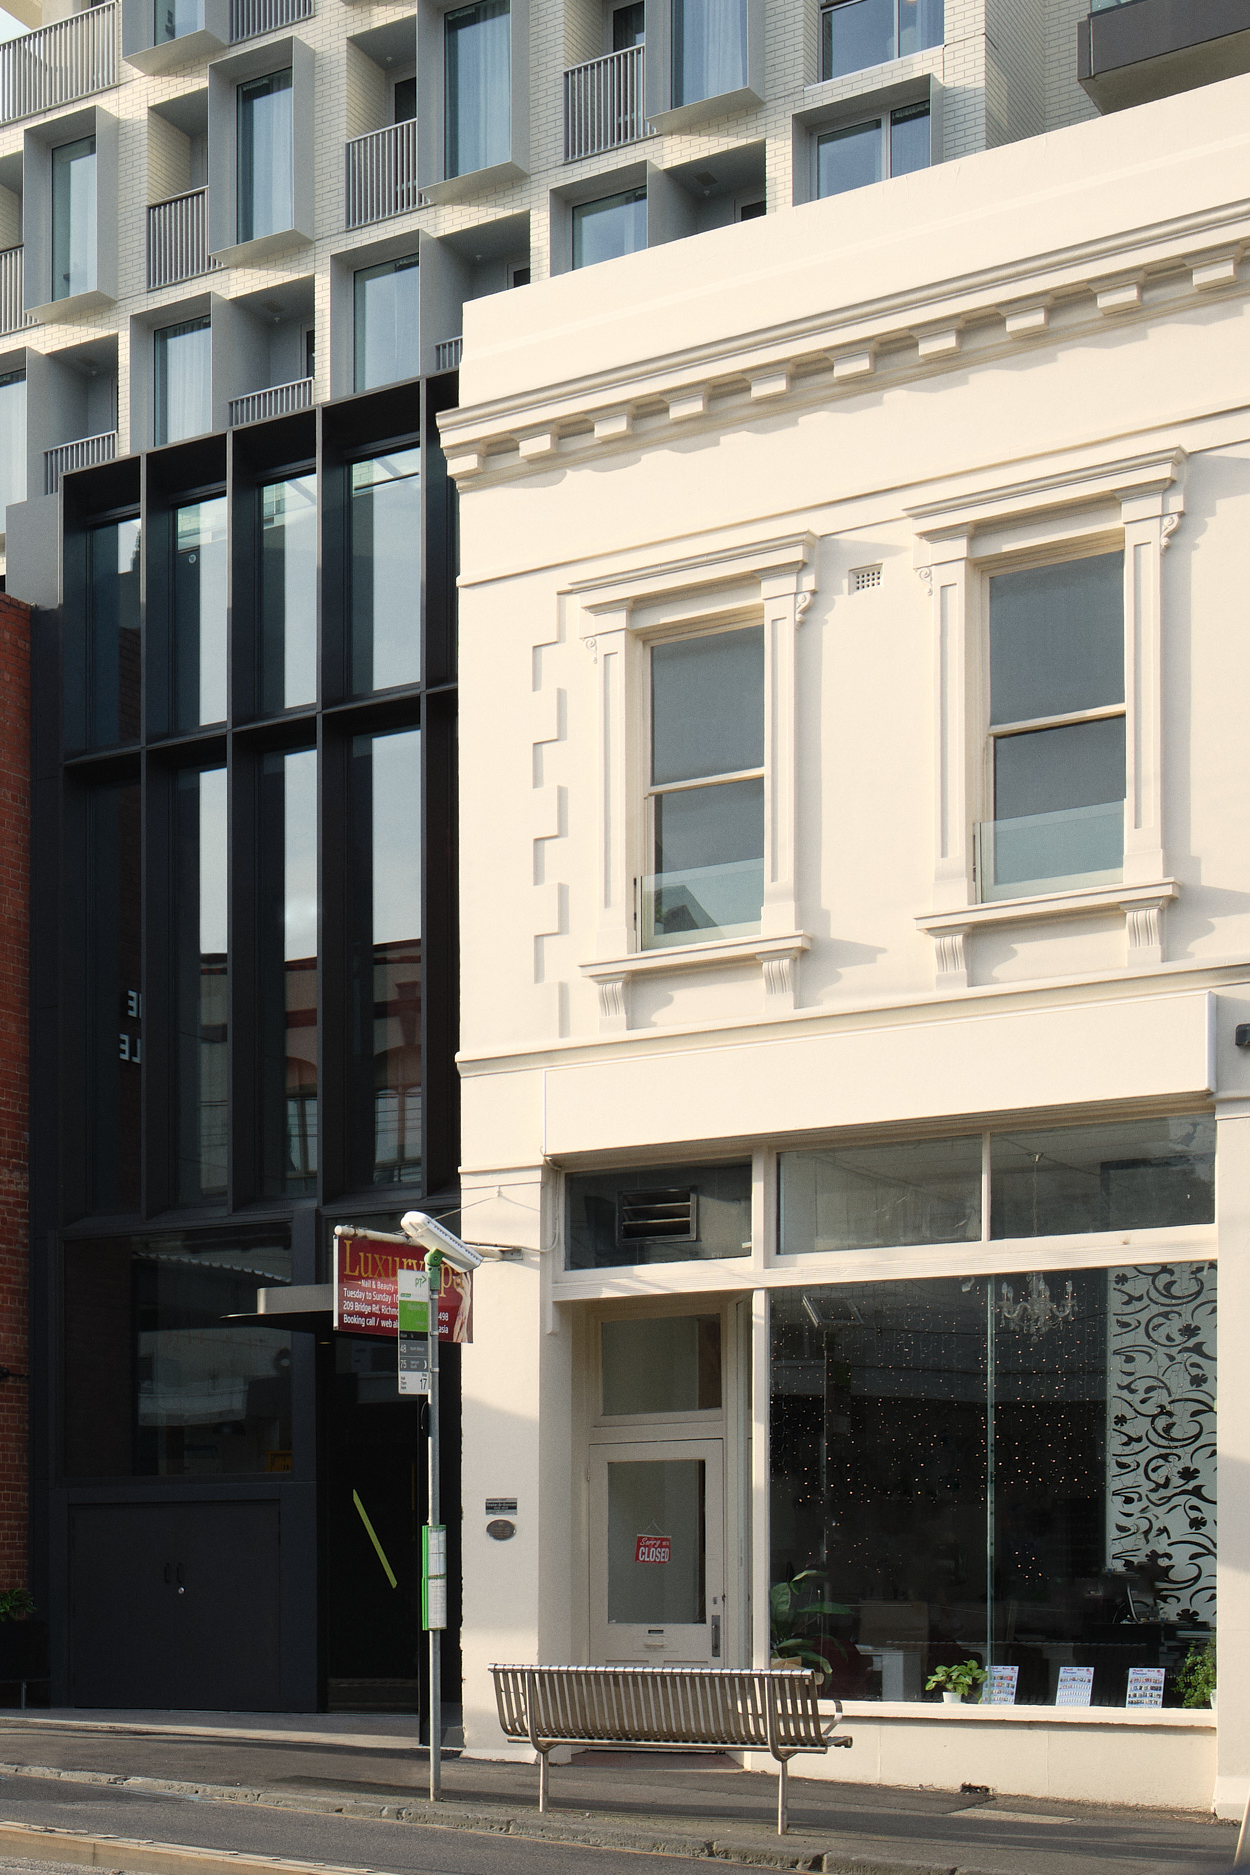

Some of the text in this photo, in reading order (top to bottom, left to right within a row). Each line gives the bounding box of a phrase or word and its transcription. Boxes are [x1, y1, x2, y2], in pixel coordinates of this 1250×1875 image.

[343, 1287, 365, 1301] Tuesday
[366, 1292, 372, 1300] to
[373, 1291, 391, 1304] Sunday
[343, 1301, 354, 1310] 209
[355, 1302, 371, 1314] Bridge
[343, 1314, 365, 1327] Booking
[366, 1316, 375, 1326] call
[381, 1319, 392, 1327] web
[400, 1360, 407, 1369] 75
[420, 1378, 428, 1390] 17
[640, 1537, 661, 1548] Sorry
[638, 1547, 670, 1562] CLOSED
